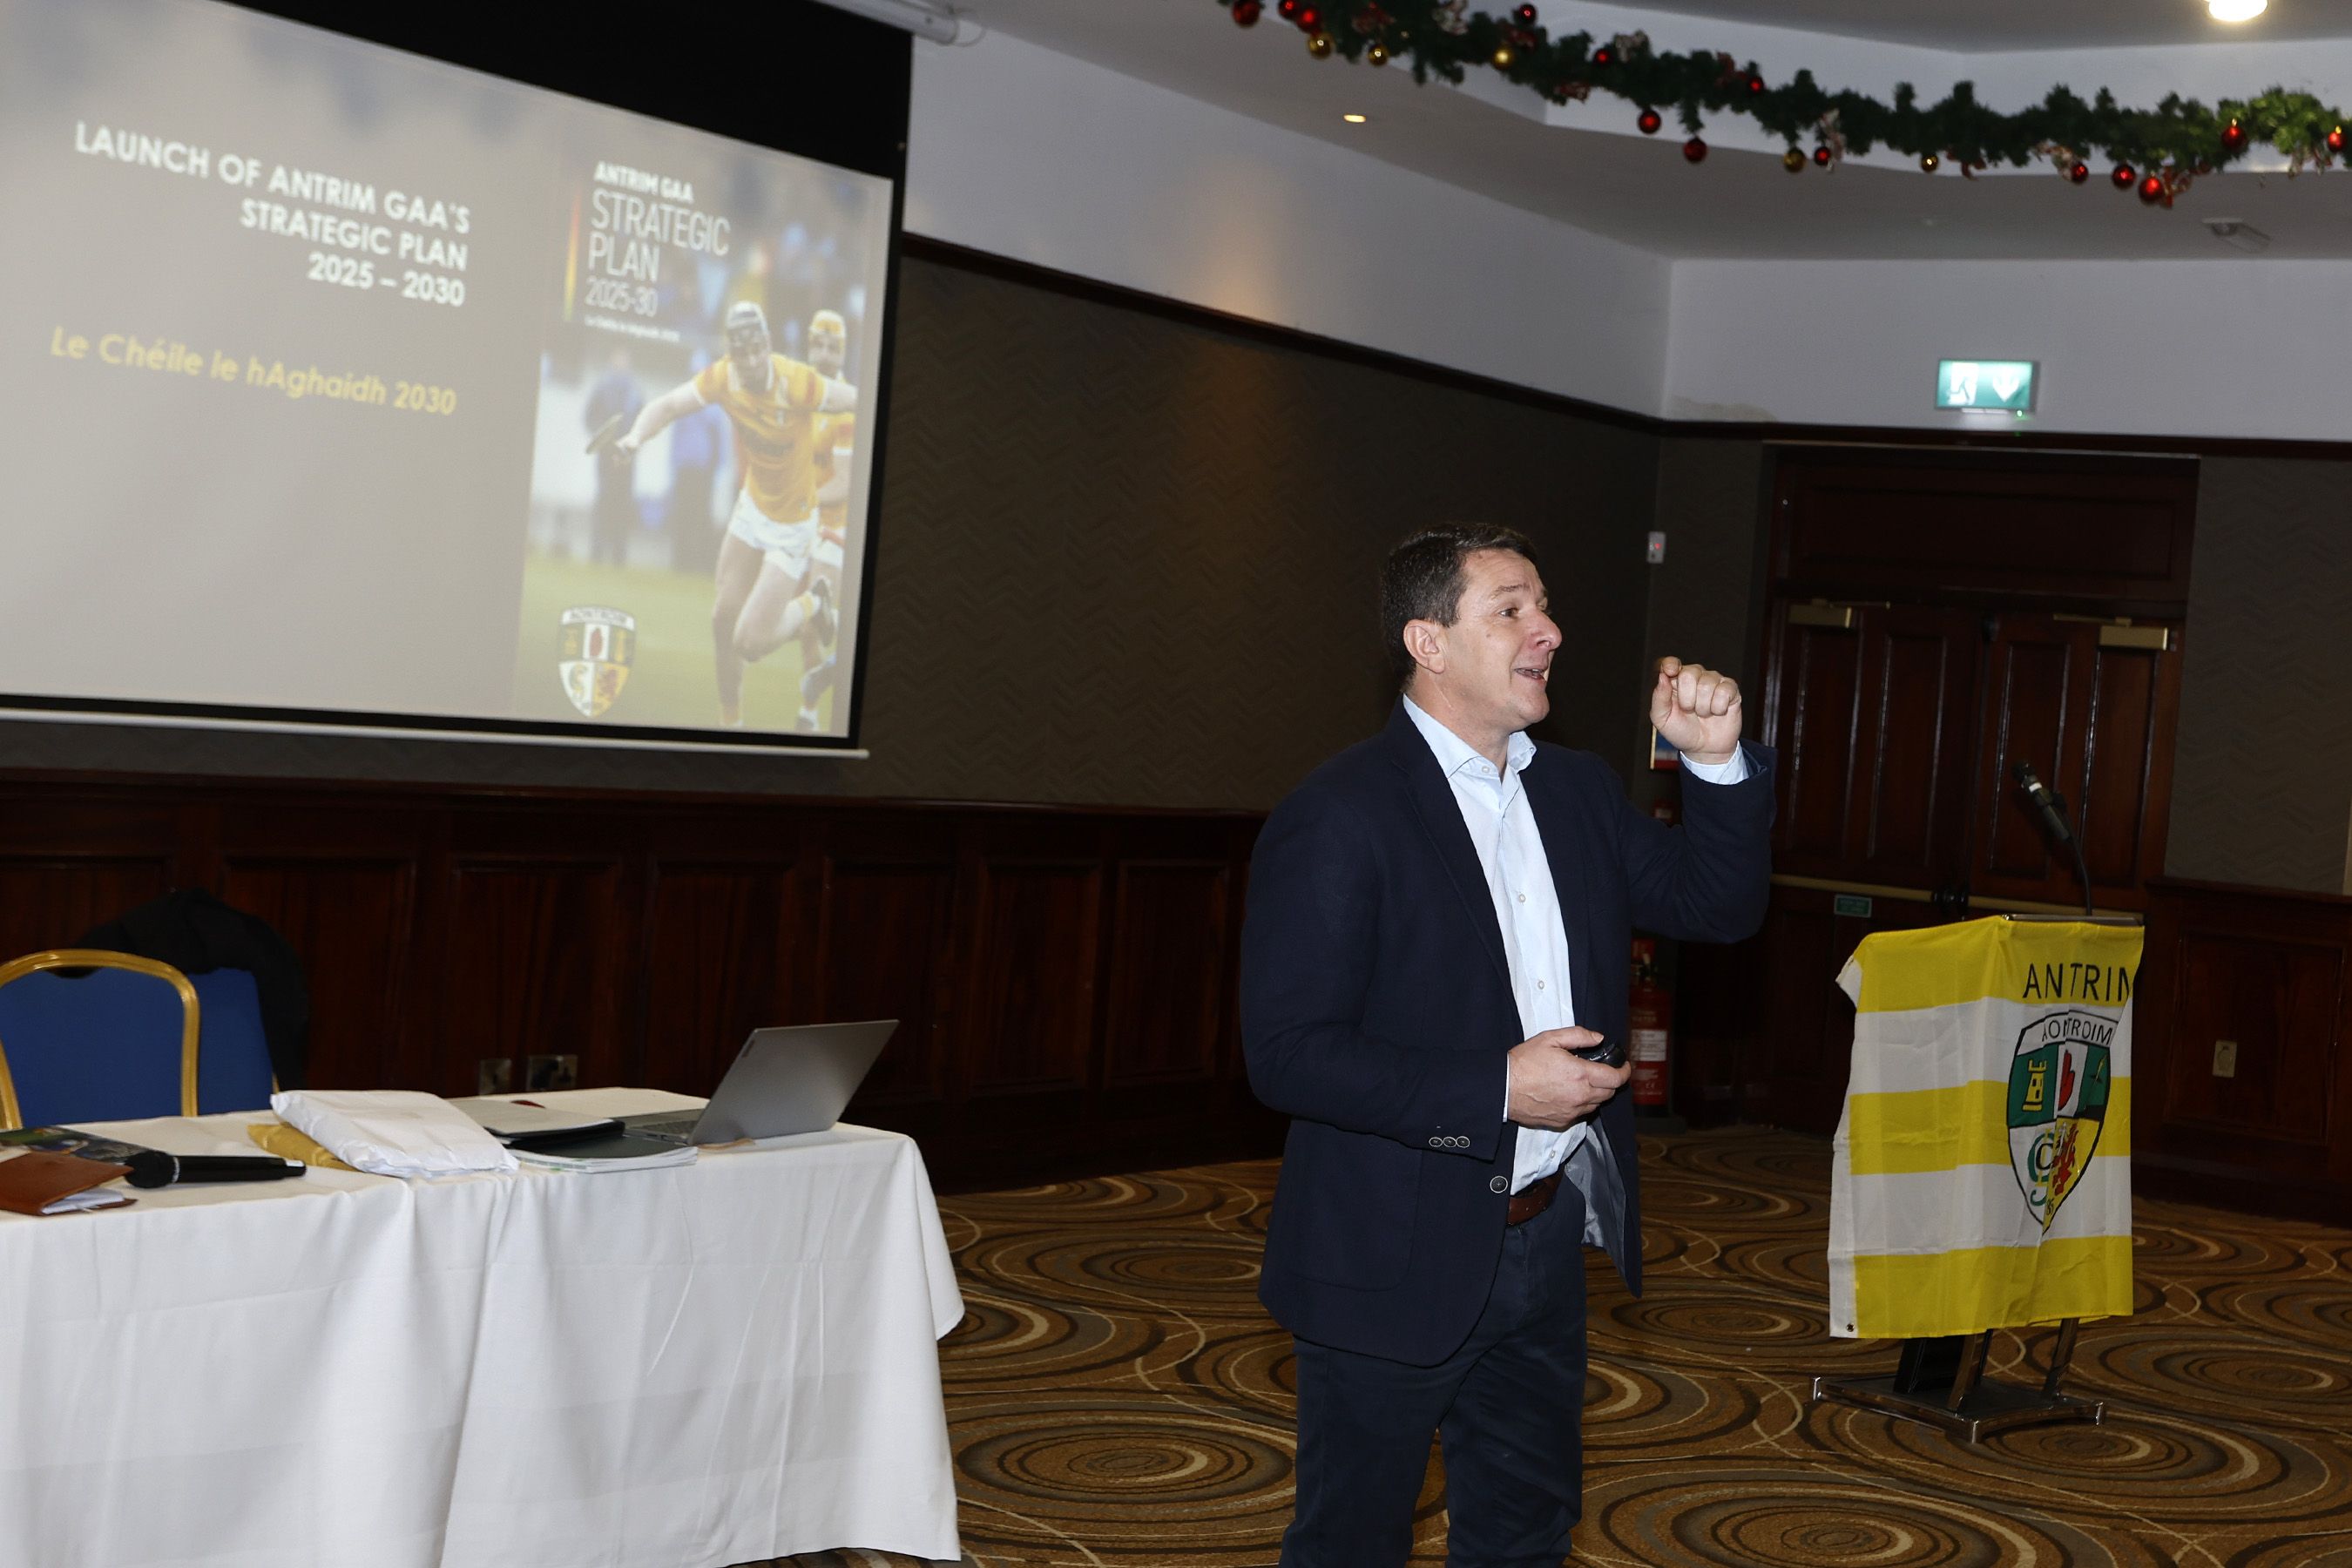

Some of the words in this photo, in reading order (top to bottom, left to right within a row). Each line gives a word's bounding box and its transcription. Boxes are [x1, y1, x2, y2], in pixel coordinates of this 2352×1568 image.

[76, 121, 210, 178] LAUNCH
[218, 153, 261, 187] OF
[267, 166, 376, 213] ANTRIM
[384, 190, 470, 233] GAA'S
[240, 198, 391, 255] STRATEGIC
[398, 231, 468, 271] PLAN
[591, 189, 730, 255] STRATEGIC
[307, 252, 375, 290] 2025
[402, 270, 466, 307] 2030
[589, 233, 659, 281] PLAN
[585, 278, 658, 316] 2025-30
[50, 325, 89, 359] Le
[98, 333, 204, 376] Chéile
[210, 350, 239, 382] le
[247, 355, 387, 404] hAghaidh
[392, 380, 457, 416] 2030
